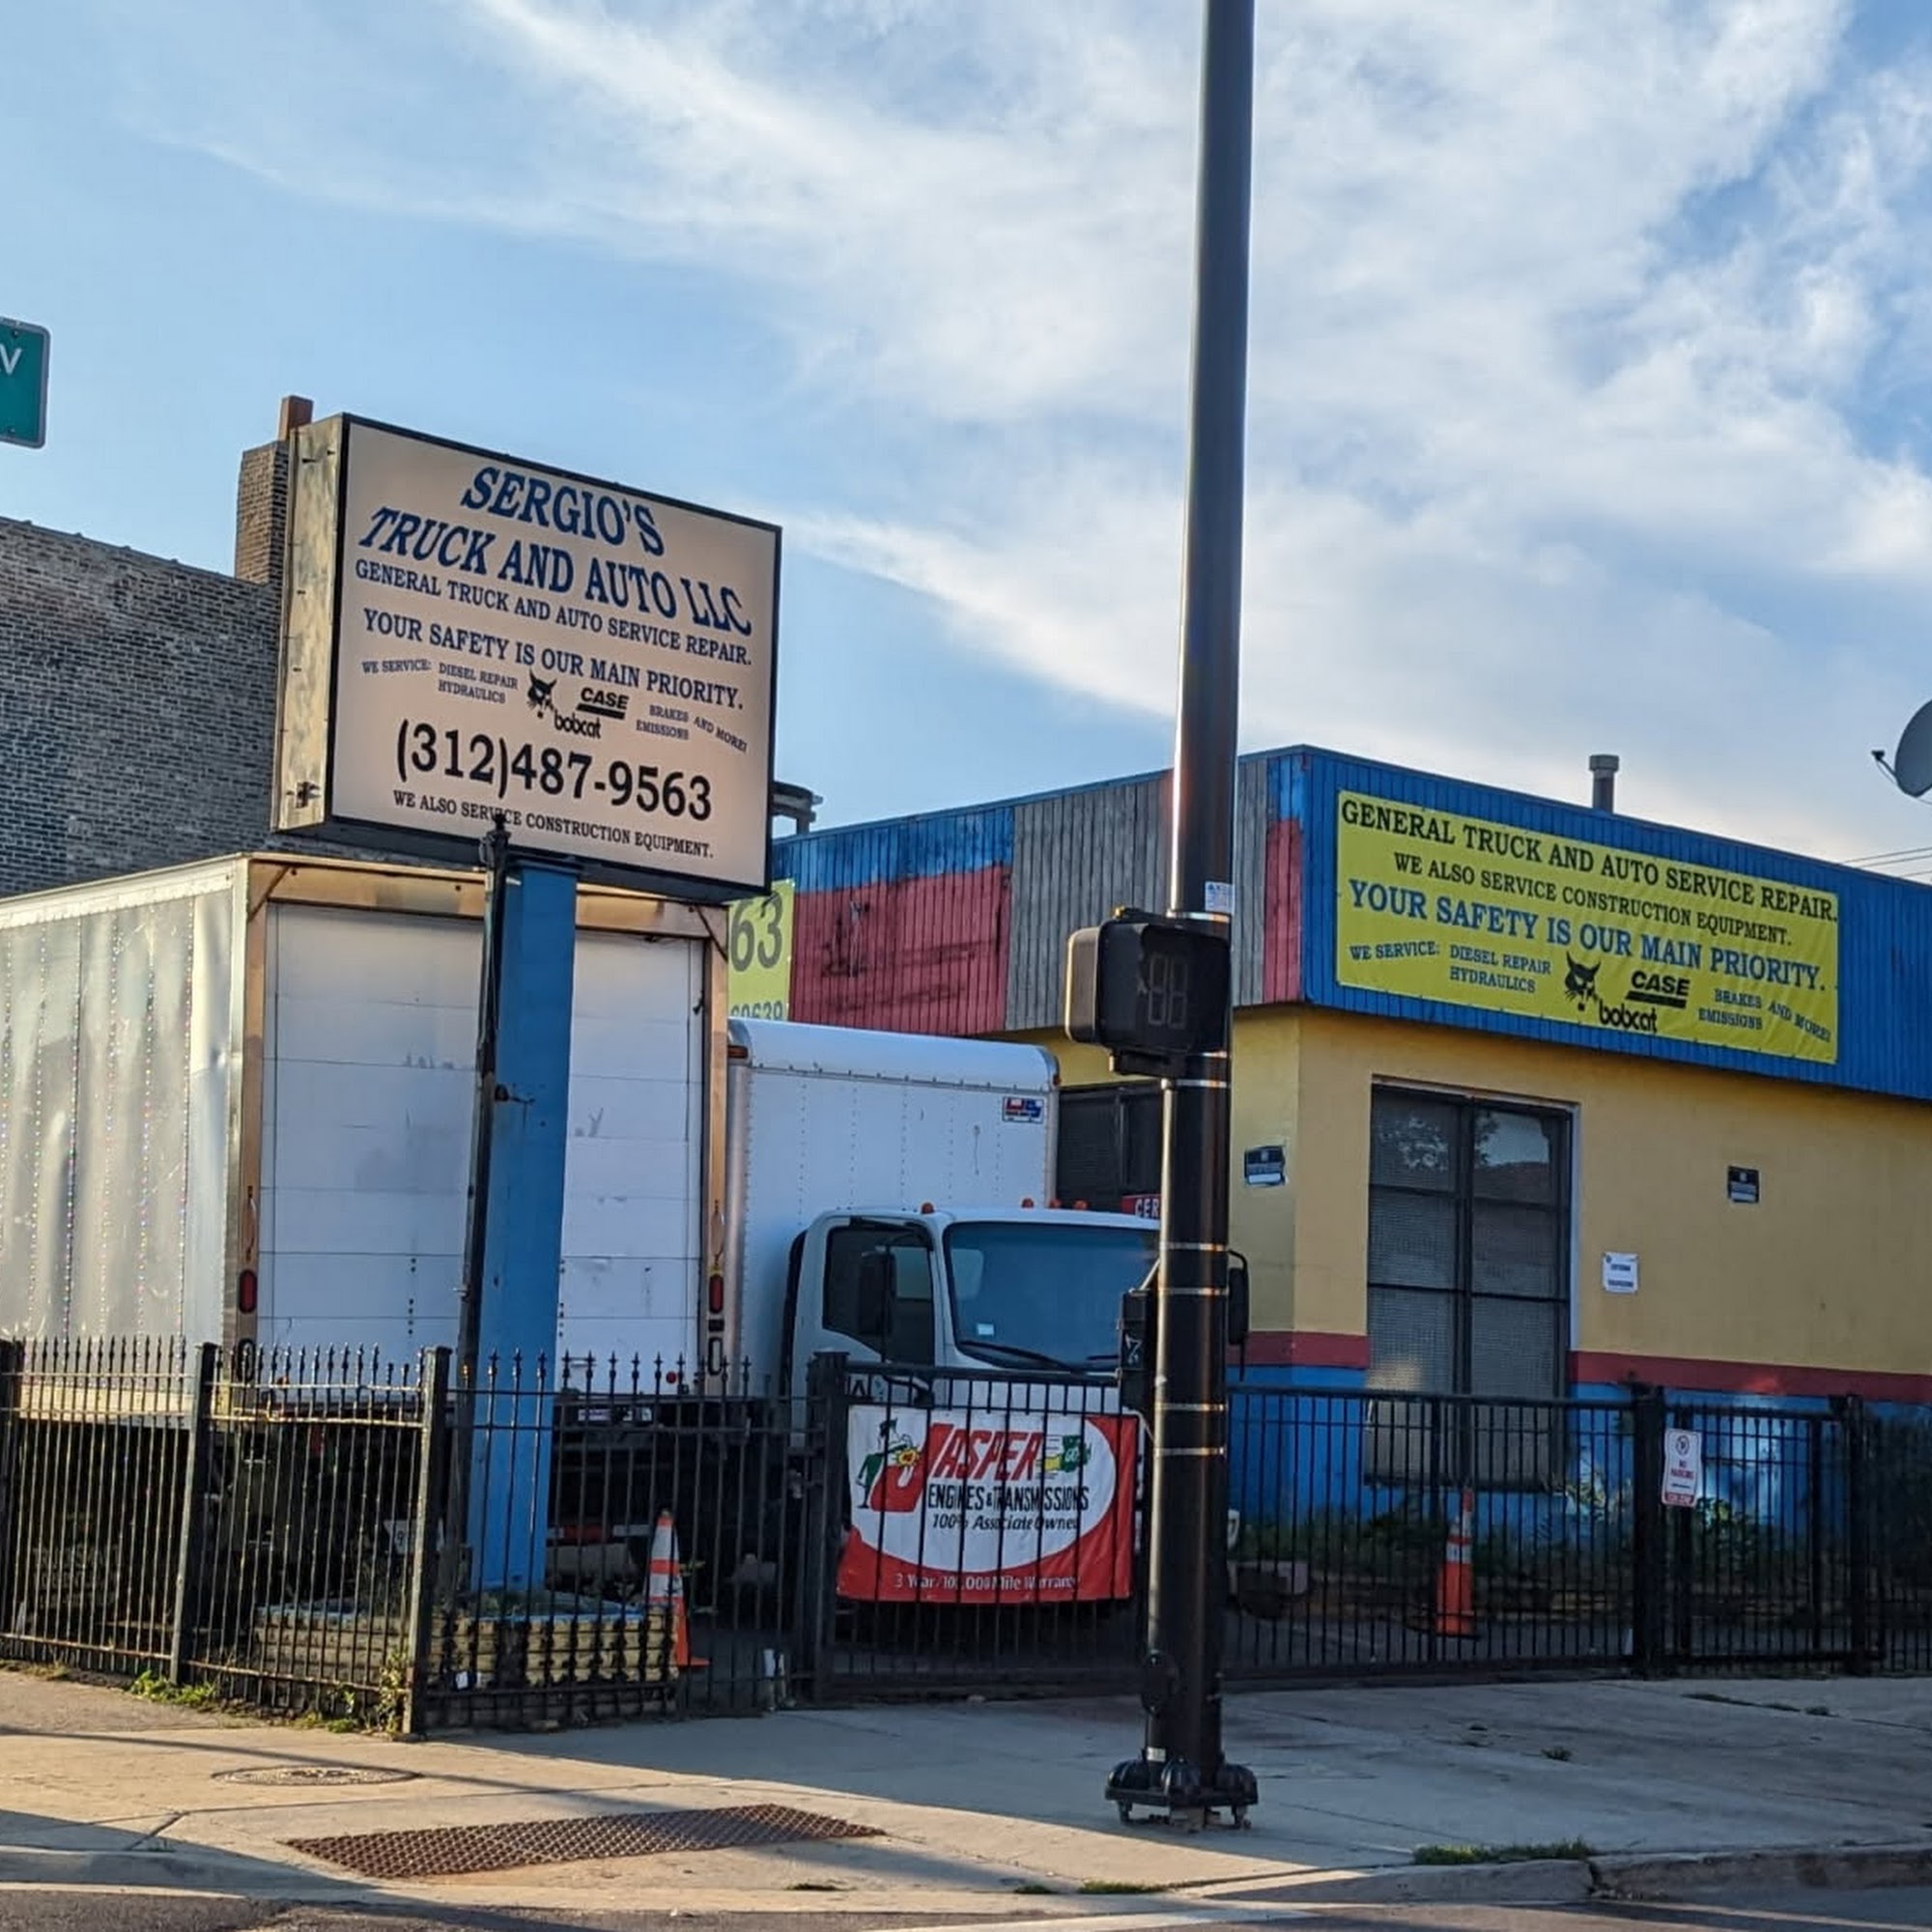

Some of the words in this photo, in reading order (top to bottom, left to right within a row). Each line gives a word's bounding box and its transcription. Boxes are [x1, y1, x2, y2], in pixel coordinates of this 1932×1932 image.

[0, 344, 21, 375] V
[460, 467, 665, 556] SERGIO'S
[358, 506, 496, 575] TRUCK
[497, 540, 574, 593] AND
[584, 557, 676, 618] AUTO
[680, 577, 752, 636] LLC
[355, 559, 441, 596] GENERAL
[447, 581, 508, 611] TRUCK
[514, 597, 551, 620] AND
[555, 606, 603, 633] AUTO
[608, 617, 681, 650] SERVICE
[685, 635, 752, 666] REPAIR.
[361, 661, 380, 673] WE
[382, 659, 432, 673] SERVICE:
[439, 663, 477, 681] DIESEL
[479, 670, 519, 690] REPAIR
[364, 609, 422, 642] YOUR
[429, 623, 509, 659] SAFETY
[515, 641, 535, 666] IS
[542, 648, 583, 676] OUR
[590, 658, 640, 688] MAIN
[646, 669, 743, 710] PRIORITY.
[438, 679, 506, 704] HYDRAULICS
[581, 687, 630, 710] CASE
[649, 704, 689, 723] BRAKES
[694, 716, 715, 733] AND
[554, 709, 602, 739] bobcat
[636, 720, 690, 740] EMISSIONS
[397, 719, 712, 821] (312)487-9563
[393, 789, 416, 809] WE
[420, 795, 458, 815] ALSO
[461, 802, 523, 827] SERVICE
[526, 812, 631, 844] CONSTRUCTION
[634, 831, 714, 858] EQUIPMENT.
[1341, 799, 1456, 845] GENERAL
[1463, 824, 1543, 863] TRUCK
[1548, 843, 1594, 872] AND
[1601, 853, 1659, 886] AUTO
[1665, 867, 1755, 905] SERVICE
[1761, 886, 1838, 922] REPAIR.
[1394, 851, 1423, 874] WE
[1428, 860, 1475, 885] ALSO
[1481, 870, 1557, 901] SERVICE
[1562, 887, 1691, 926] CONSTRUCTION
[1696, 912, 1792, 947] EQUIPMENT.
[1349, 879, 1428, 920] YOUR
[1436, 896, 1539, 939] SAFETY
[1547, 917, 1572, 947] IS
[1579, 923, 1633, 956] OUR
[1640, 933, 1703, 969] MAIN
[1710, 947, 1826, 991] PRIORITY.
[1350, 945, 1372, 960] WE
[1376, 940, 1440, 959] SERVICE:
[1449, 944, 1498, 966] DIESEL
[1502, 953, 1551, 975] REPAIR
[1449, 966, 1536, 993] HYDRAULICS
[1631, 970, 1690, 996] CASE
[1714, 987, 1762, 1009] BRAKES
[1768, 1000, 1792, 1021] AND
[1599, 998, 1658, 1033] bobcat
[1698, 1008, 1763, 1030] EMISSIONS
[869, 1422, 1044, 1513] JASPER
[993, 1485, 1091, 1512] TRANSMSSIONS
